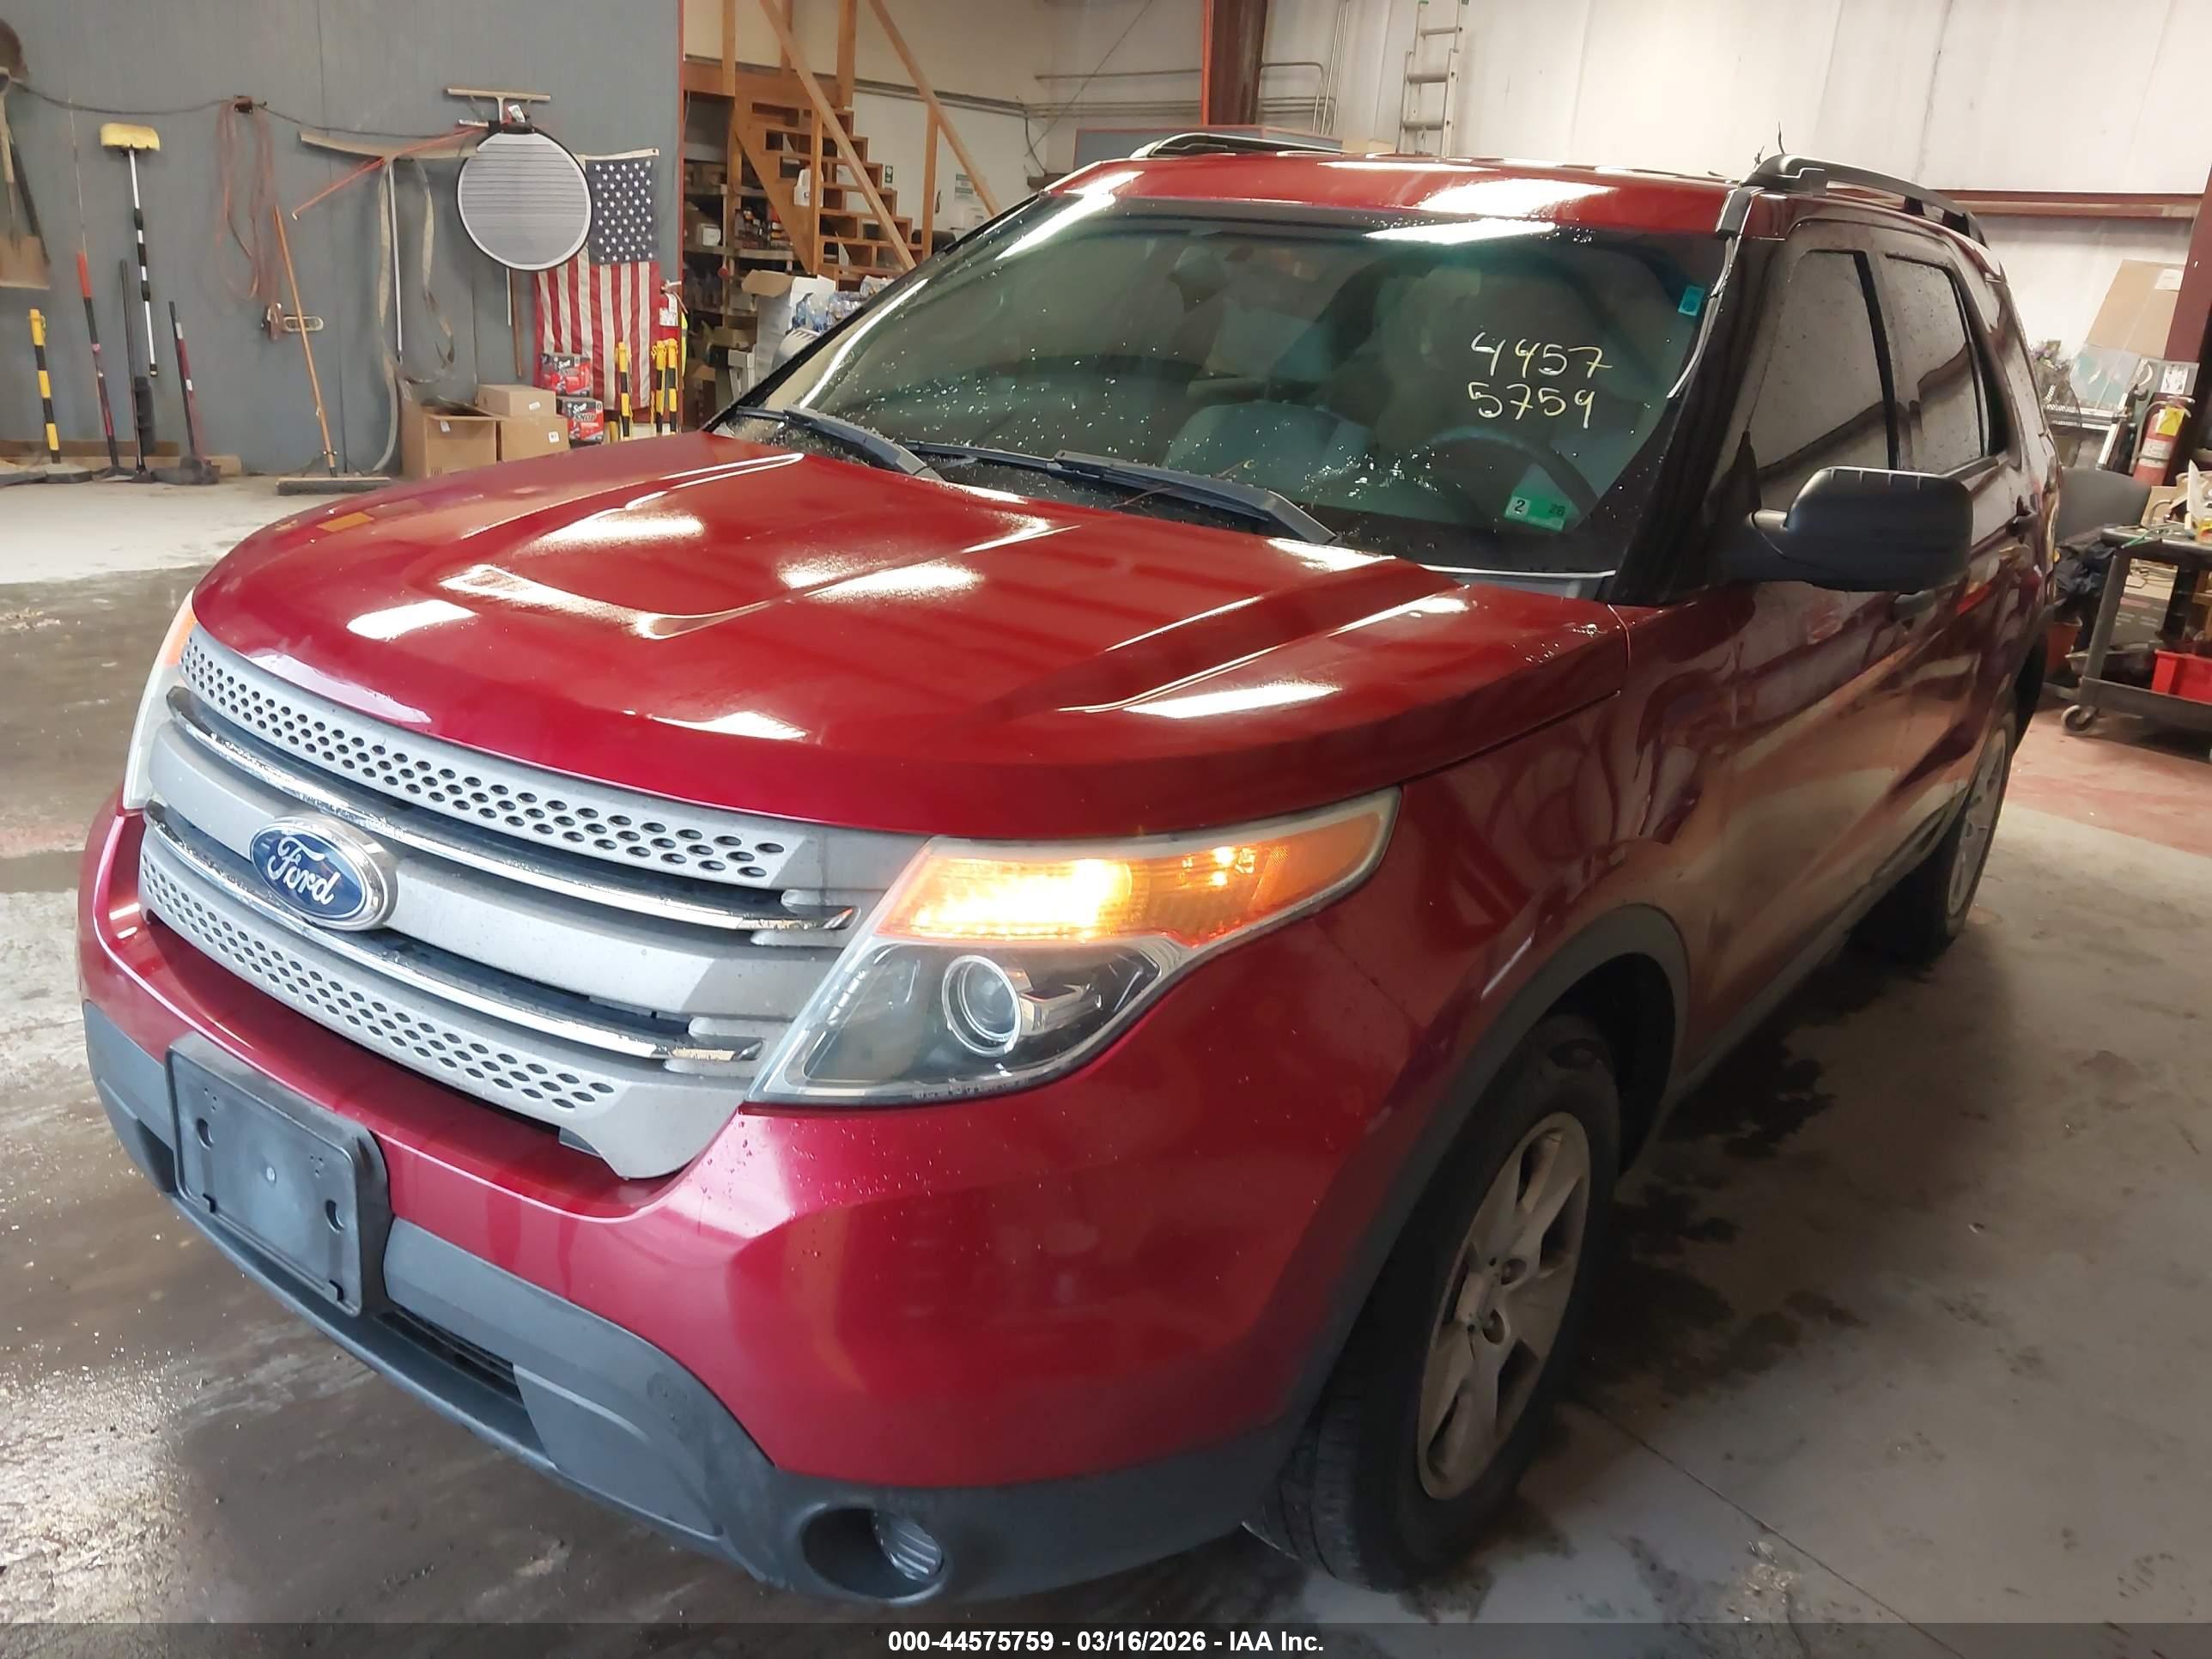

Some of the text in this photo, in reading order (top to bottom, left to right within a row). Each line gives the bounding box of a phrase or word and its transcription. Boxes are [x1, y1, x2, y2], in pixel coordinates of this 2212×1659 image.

[1470, 331, 1613, 379] 4457
[1468, 381, 1595, 429] 5759
[1514, 499, 1526, 513] 2
[267, 836, 341, 905] Ford
